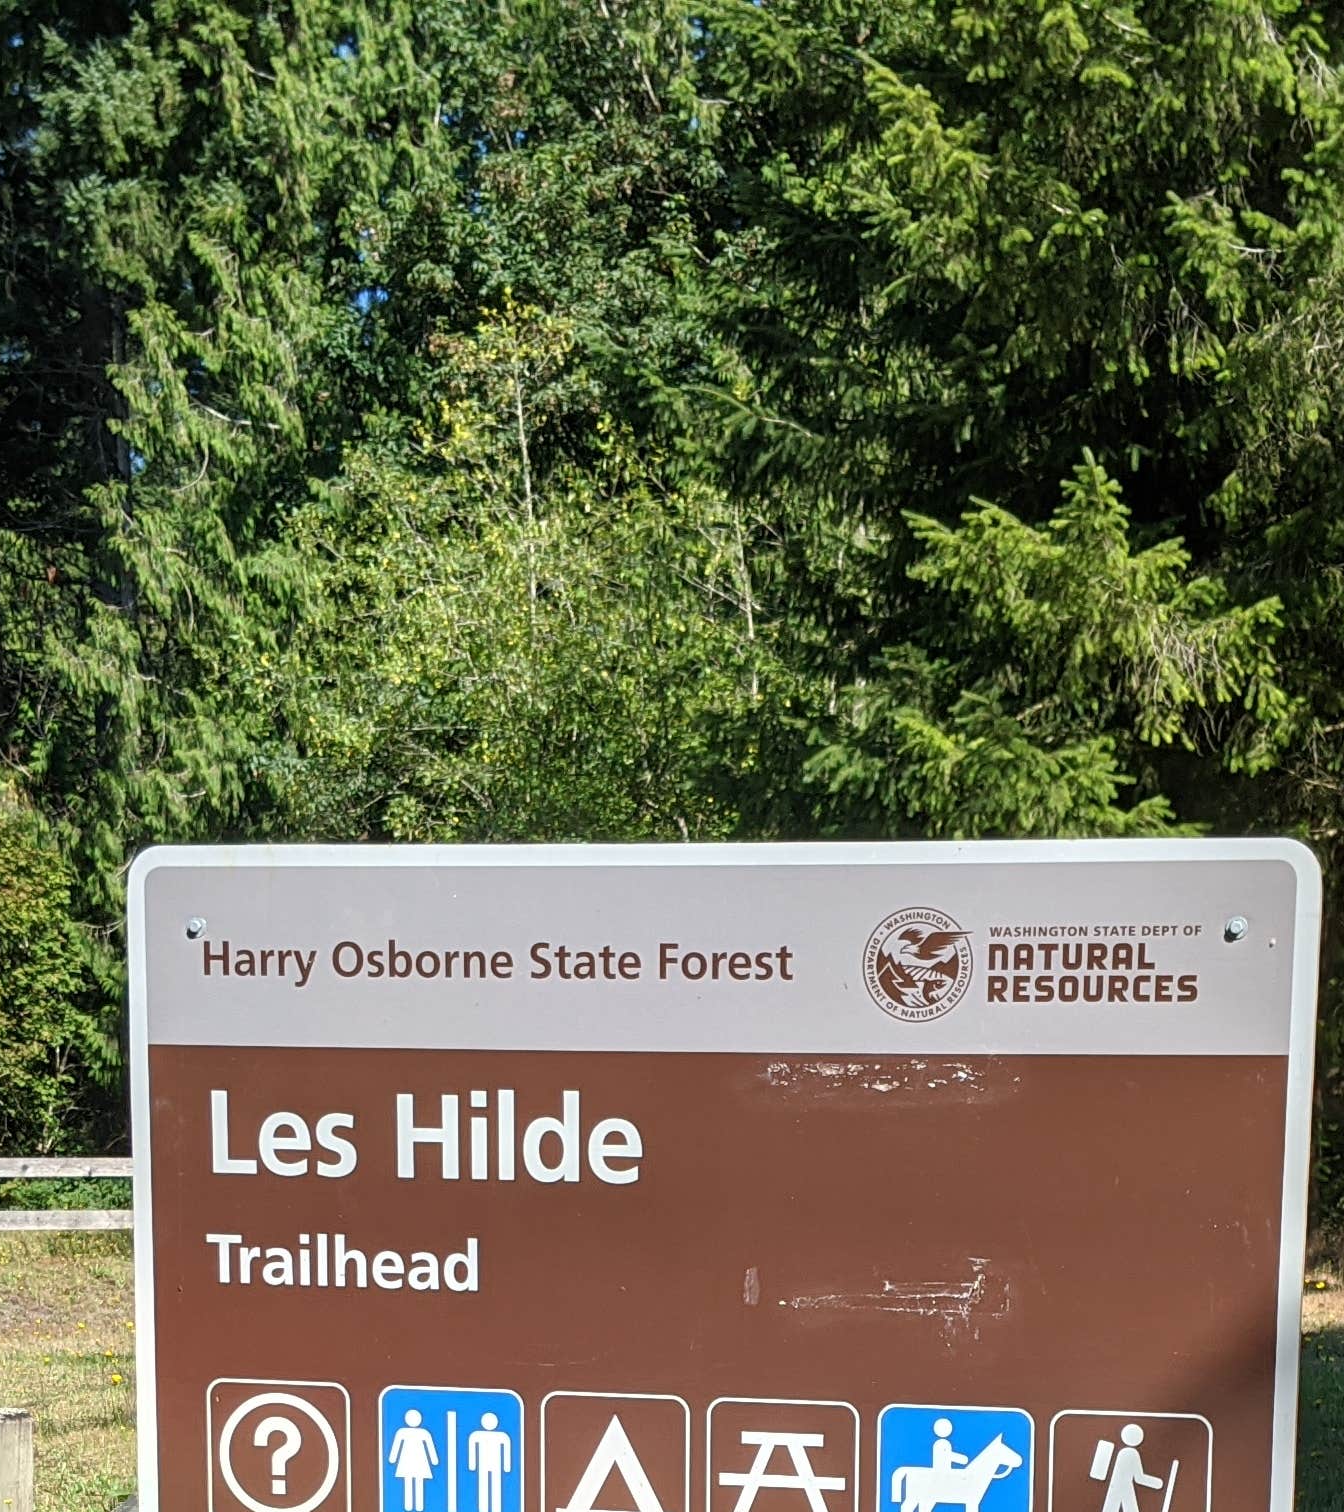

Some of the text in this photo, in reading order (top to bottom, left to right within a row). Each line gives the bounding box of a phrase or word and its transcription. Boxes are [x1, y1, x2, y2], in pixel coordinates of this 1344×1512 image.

[884, 911, 951, 931] WASHINGTON
[989, 925, 1202, 937] WASHINGTON STATE DEPT OF
[203, 940, 793, 986] Harry Osborne State Forest
[988, 943, 1155, 970] NATURAL
[865, 937, 887, 1004] DEPARTMENT
[885, 1001, 898, 1013] OF
[901, 1003, 947, 1019] NATURAL
[987, 975, 1198, 1003] RESOURCES
[210, 1089, 643, 1185] Les Hilde
[206, 1233, 479, 1292] Trailhead
